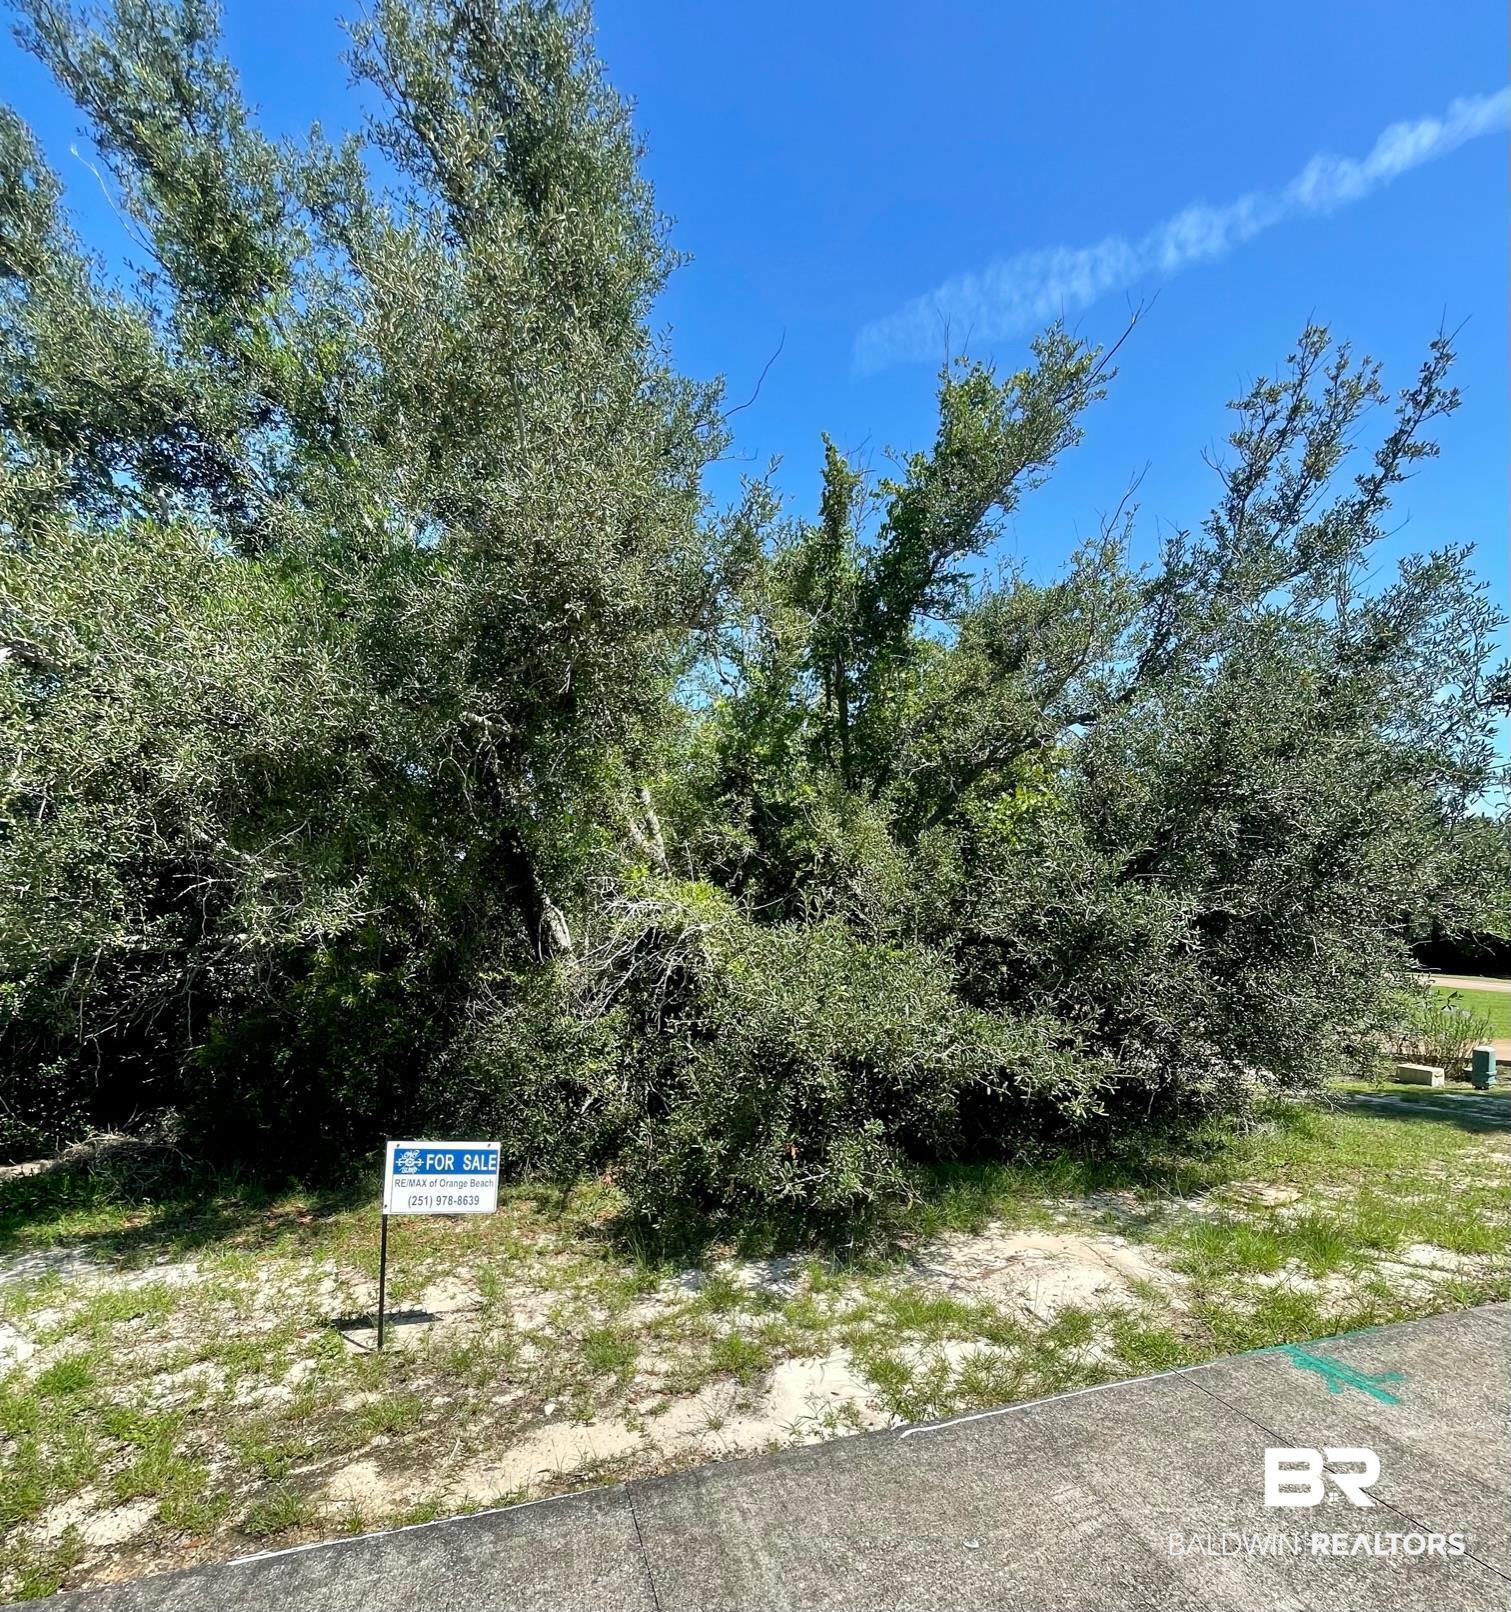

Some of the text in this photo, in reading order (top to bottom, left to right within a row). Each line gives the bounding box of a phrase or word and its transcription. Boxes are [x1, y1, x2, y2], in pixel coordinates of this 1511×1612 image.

[426, 1154, 454, 1171] FOR
[463, 1154, 497, 1171] SALE
[394, 1178, 494, 1190] RE/MAX of Orange Beach
[408, 1195, 480, 1208] (251) 978-8639
